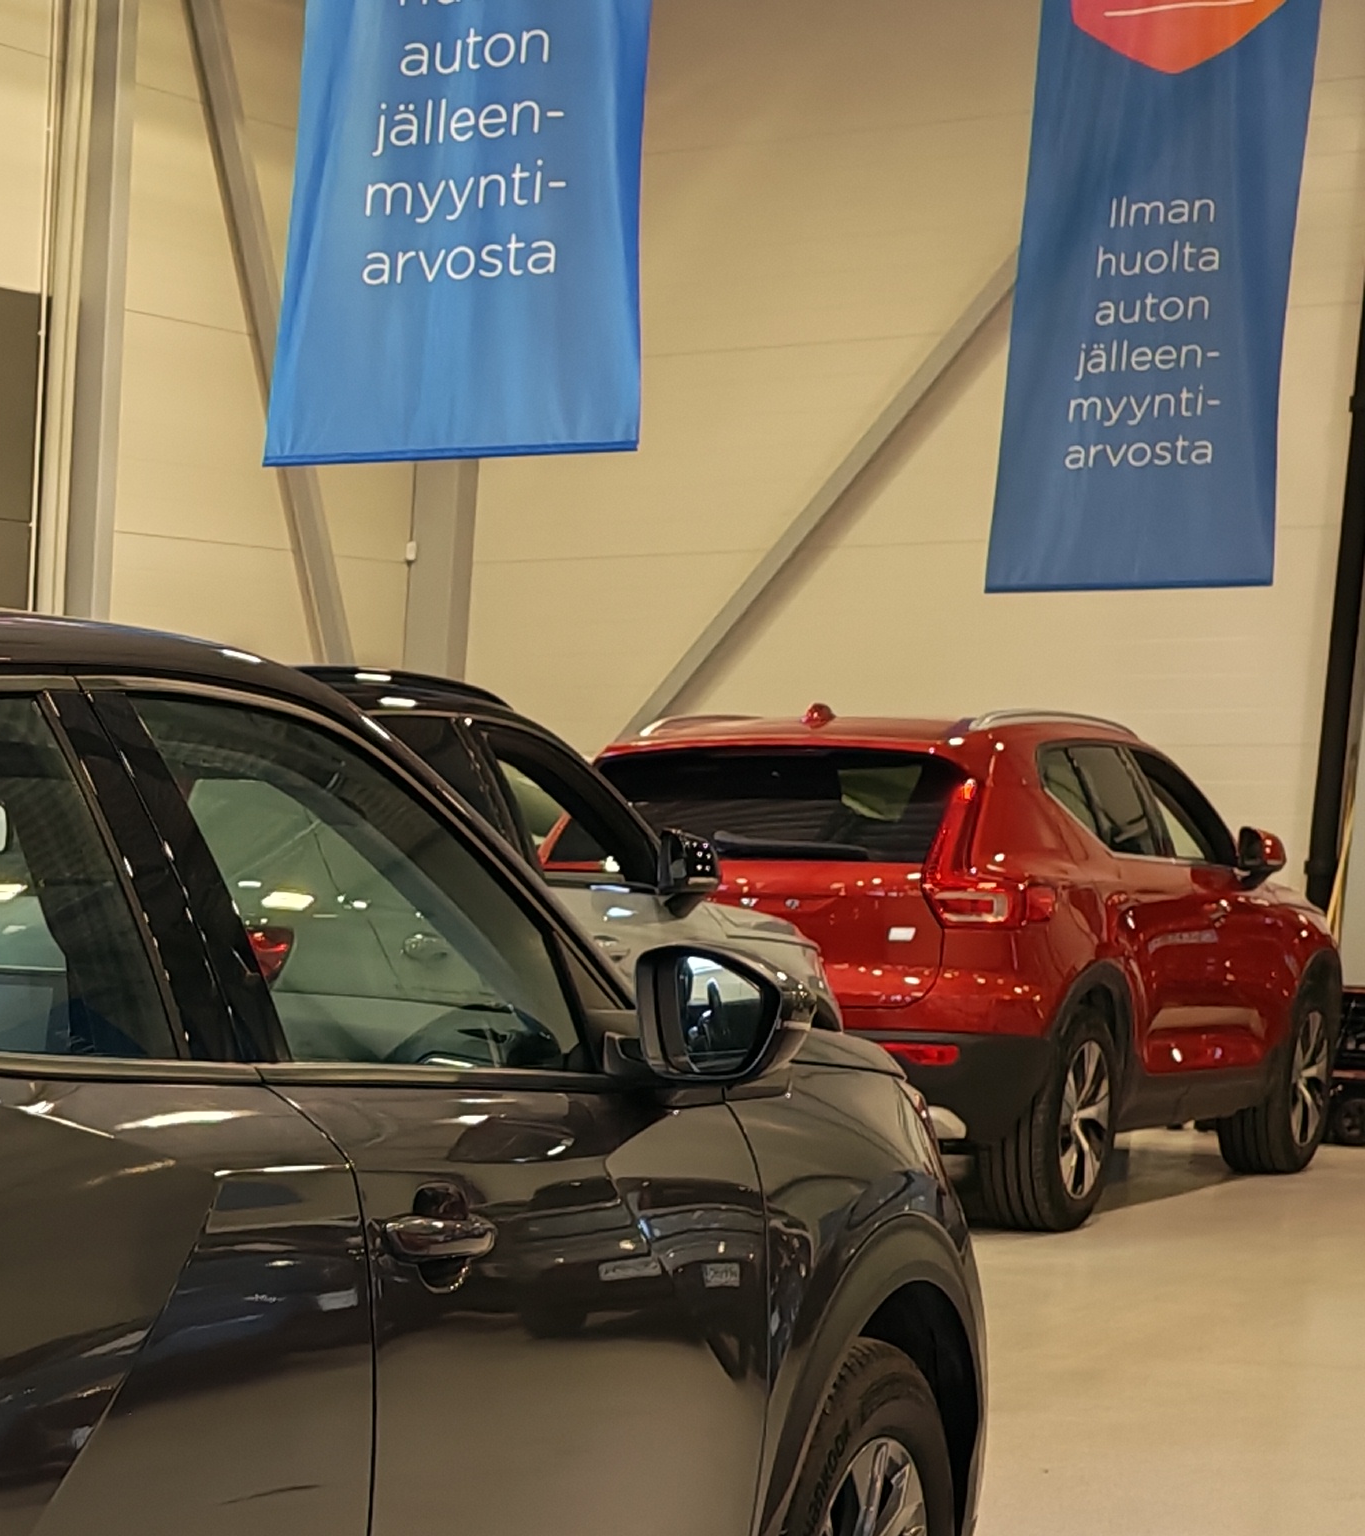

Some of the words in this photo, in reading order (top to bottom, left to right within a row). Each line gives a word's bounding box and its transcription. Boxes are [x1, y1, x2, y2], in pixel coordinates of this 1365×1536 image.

[399, 27, 551, 77] auton
[371, 98, 566, 157] jälleen-
[364, 159, 567, 224] myynti-
[1108, 197, 1217, 230] Ilman
[361, 233, 557, 286] arvosta
[1095, 240, 1221, 279] huolta
[1094, 293, 1210, 326] auton
[1073, 340, 1221, 381] jälleen-
[1067, 384, 1222, 428] myynti-
[1063, 437, 1214, 470] arvosta
